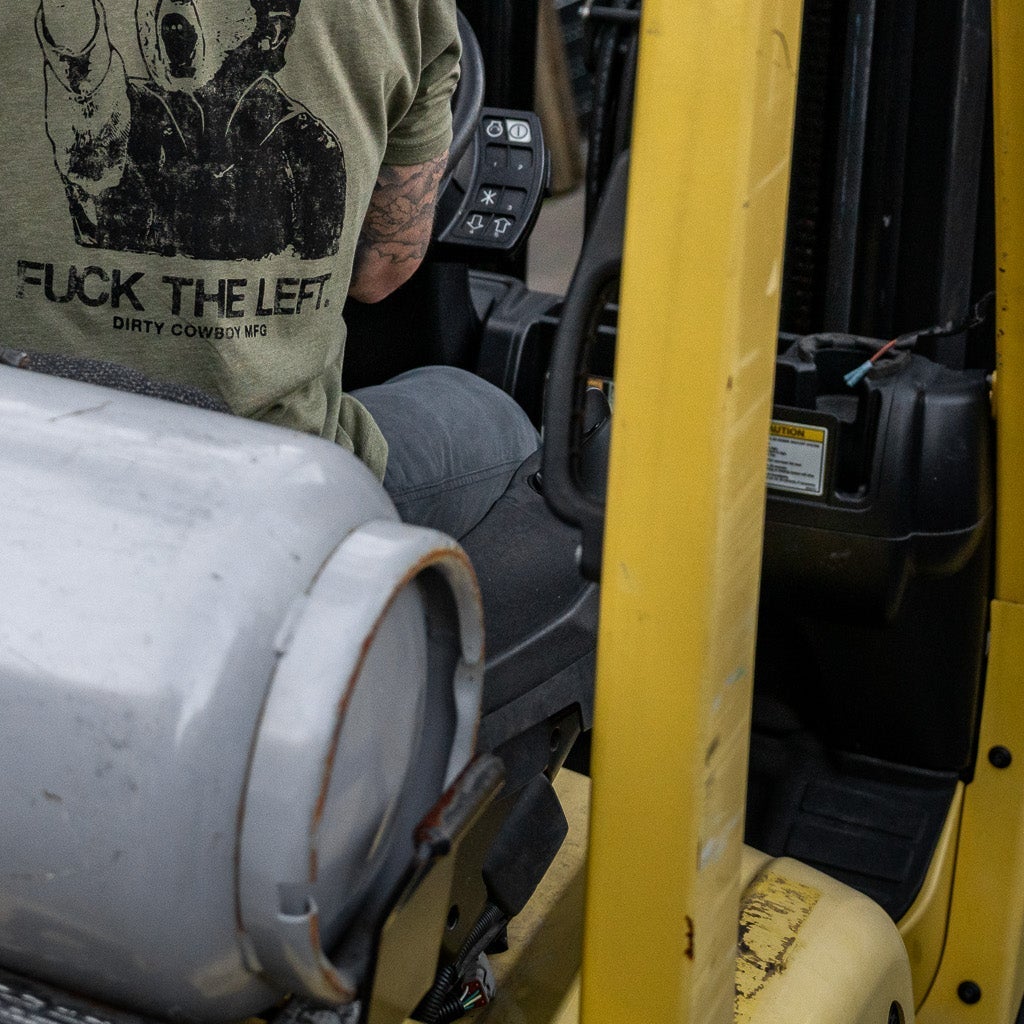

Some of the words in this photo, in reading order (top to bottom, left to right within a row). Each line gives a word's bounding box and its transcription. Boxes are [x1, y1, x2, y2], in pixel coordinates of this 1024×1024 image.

[16, 260, 146, 312] FUCK
[161, 275, 248, 318] THE
[255, 273, 332, 317] LEFT.
[112, 315, 165, 336] DIRTY
[170, 322, 242, 340] COWBOY
[244, 323, 268, 339] MFG
